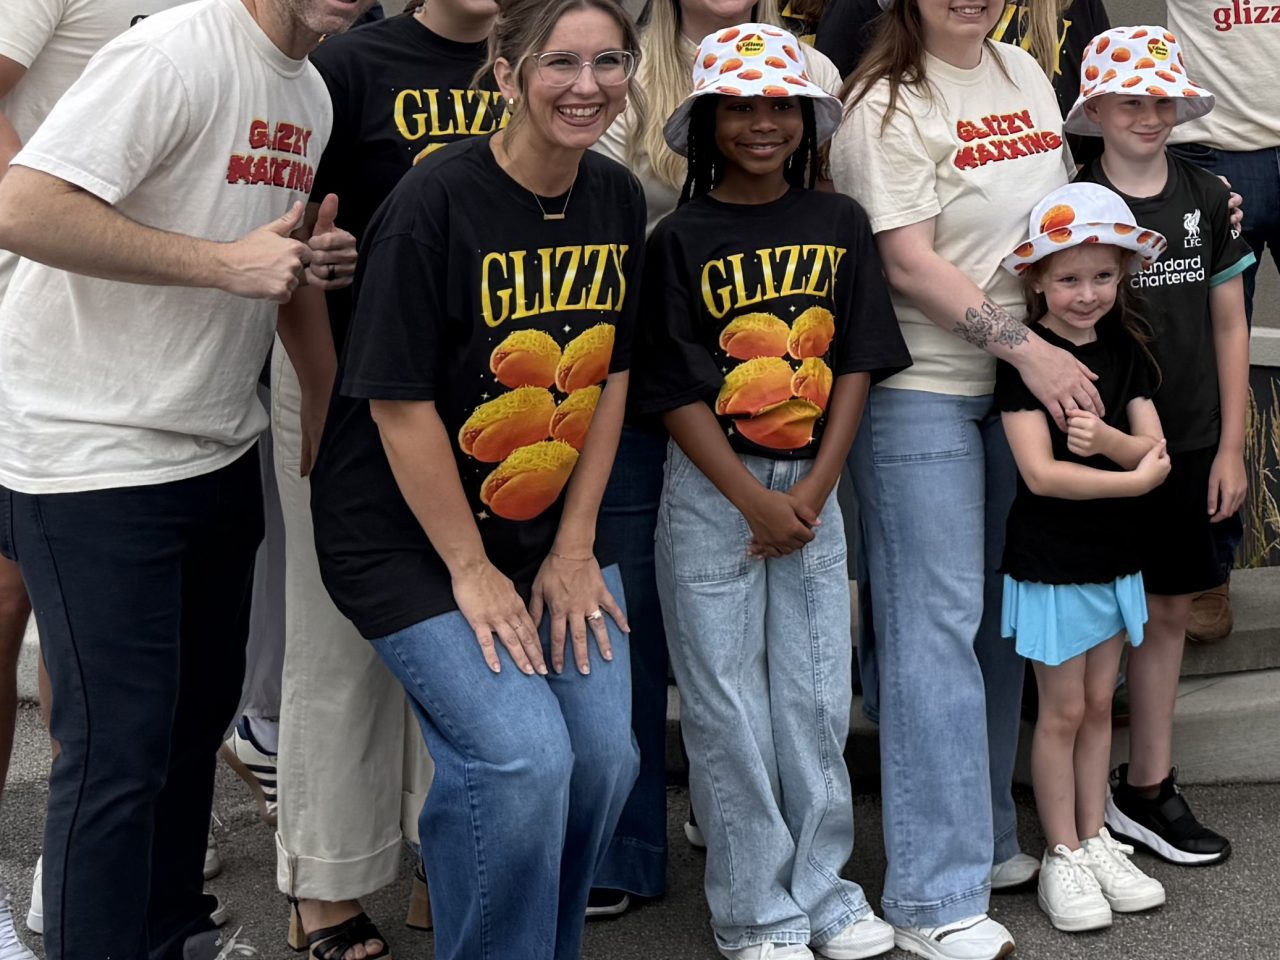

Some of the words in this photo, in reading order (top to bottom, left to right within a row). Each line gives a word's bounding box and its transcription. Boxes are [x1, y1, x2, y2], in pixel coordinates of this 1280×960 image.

[393, 88, 512, 141] GLIZ
[957, 109, 1034, 142] GLIZZY
[248, 118, 313, 158] GIZZY
[954, 131, 1063, 171] MAXXING
[1184, 239, 1203, 248] LFC
[481, 244, 629, 328] GLIZZY
[701, 245, 847, 319] GLIZZY
[1130, 268, 1205, 289] chartered
